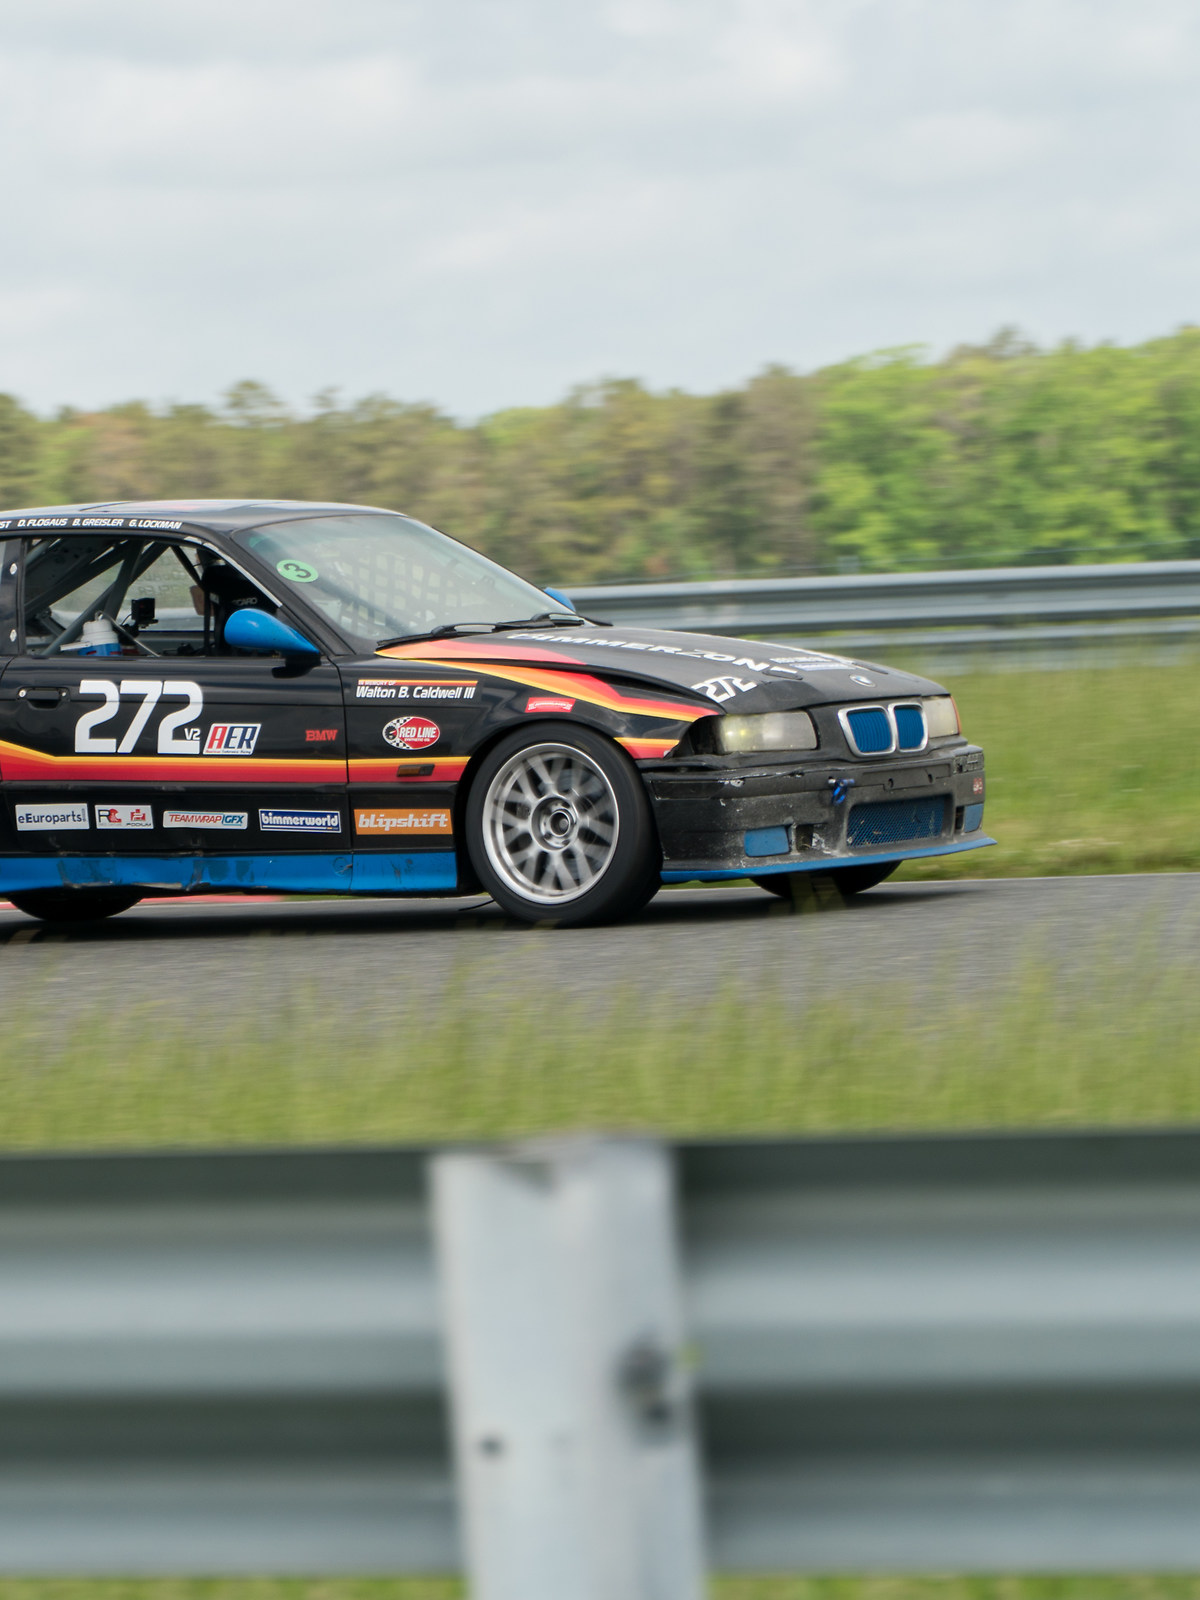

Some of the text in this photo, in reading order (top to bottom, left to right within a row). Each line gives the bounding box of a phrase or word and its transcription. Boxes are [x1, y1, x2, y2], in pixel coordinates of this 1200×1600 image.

[17, 519, 26, 527] D.
[26, 518, 68, 527] FLOGAUS
[72, 518, 82, 527] B.
[82, 518, 124, 527] GREISLER
[138, 519, 183, 530] LOCKMAN
[356, 686, 396, 698] Walton
[398, 686, 410, 698] B.
[413, 686, 461, 699] Caldwell
[74, 679, 204, 755] 272
[207, 726, 258, 749] AER
[305, 729, 338, 741] BMW
[400, 727, 437, 738] RED LINE
[17, 810, 82, 825] eEuroparts
[261, 812, 339, 827] bimmerworld
[358, 814, 449, 831] blipshift
